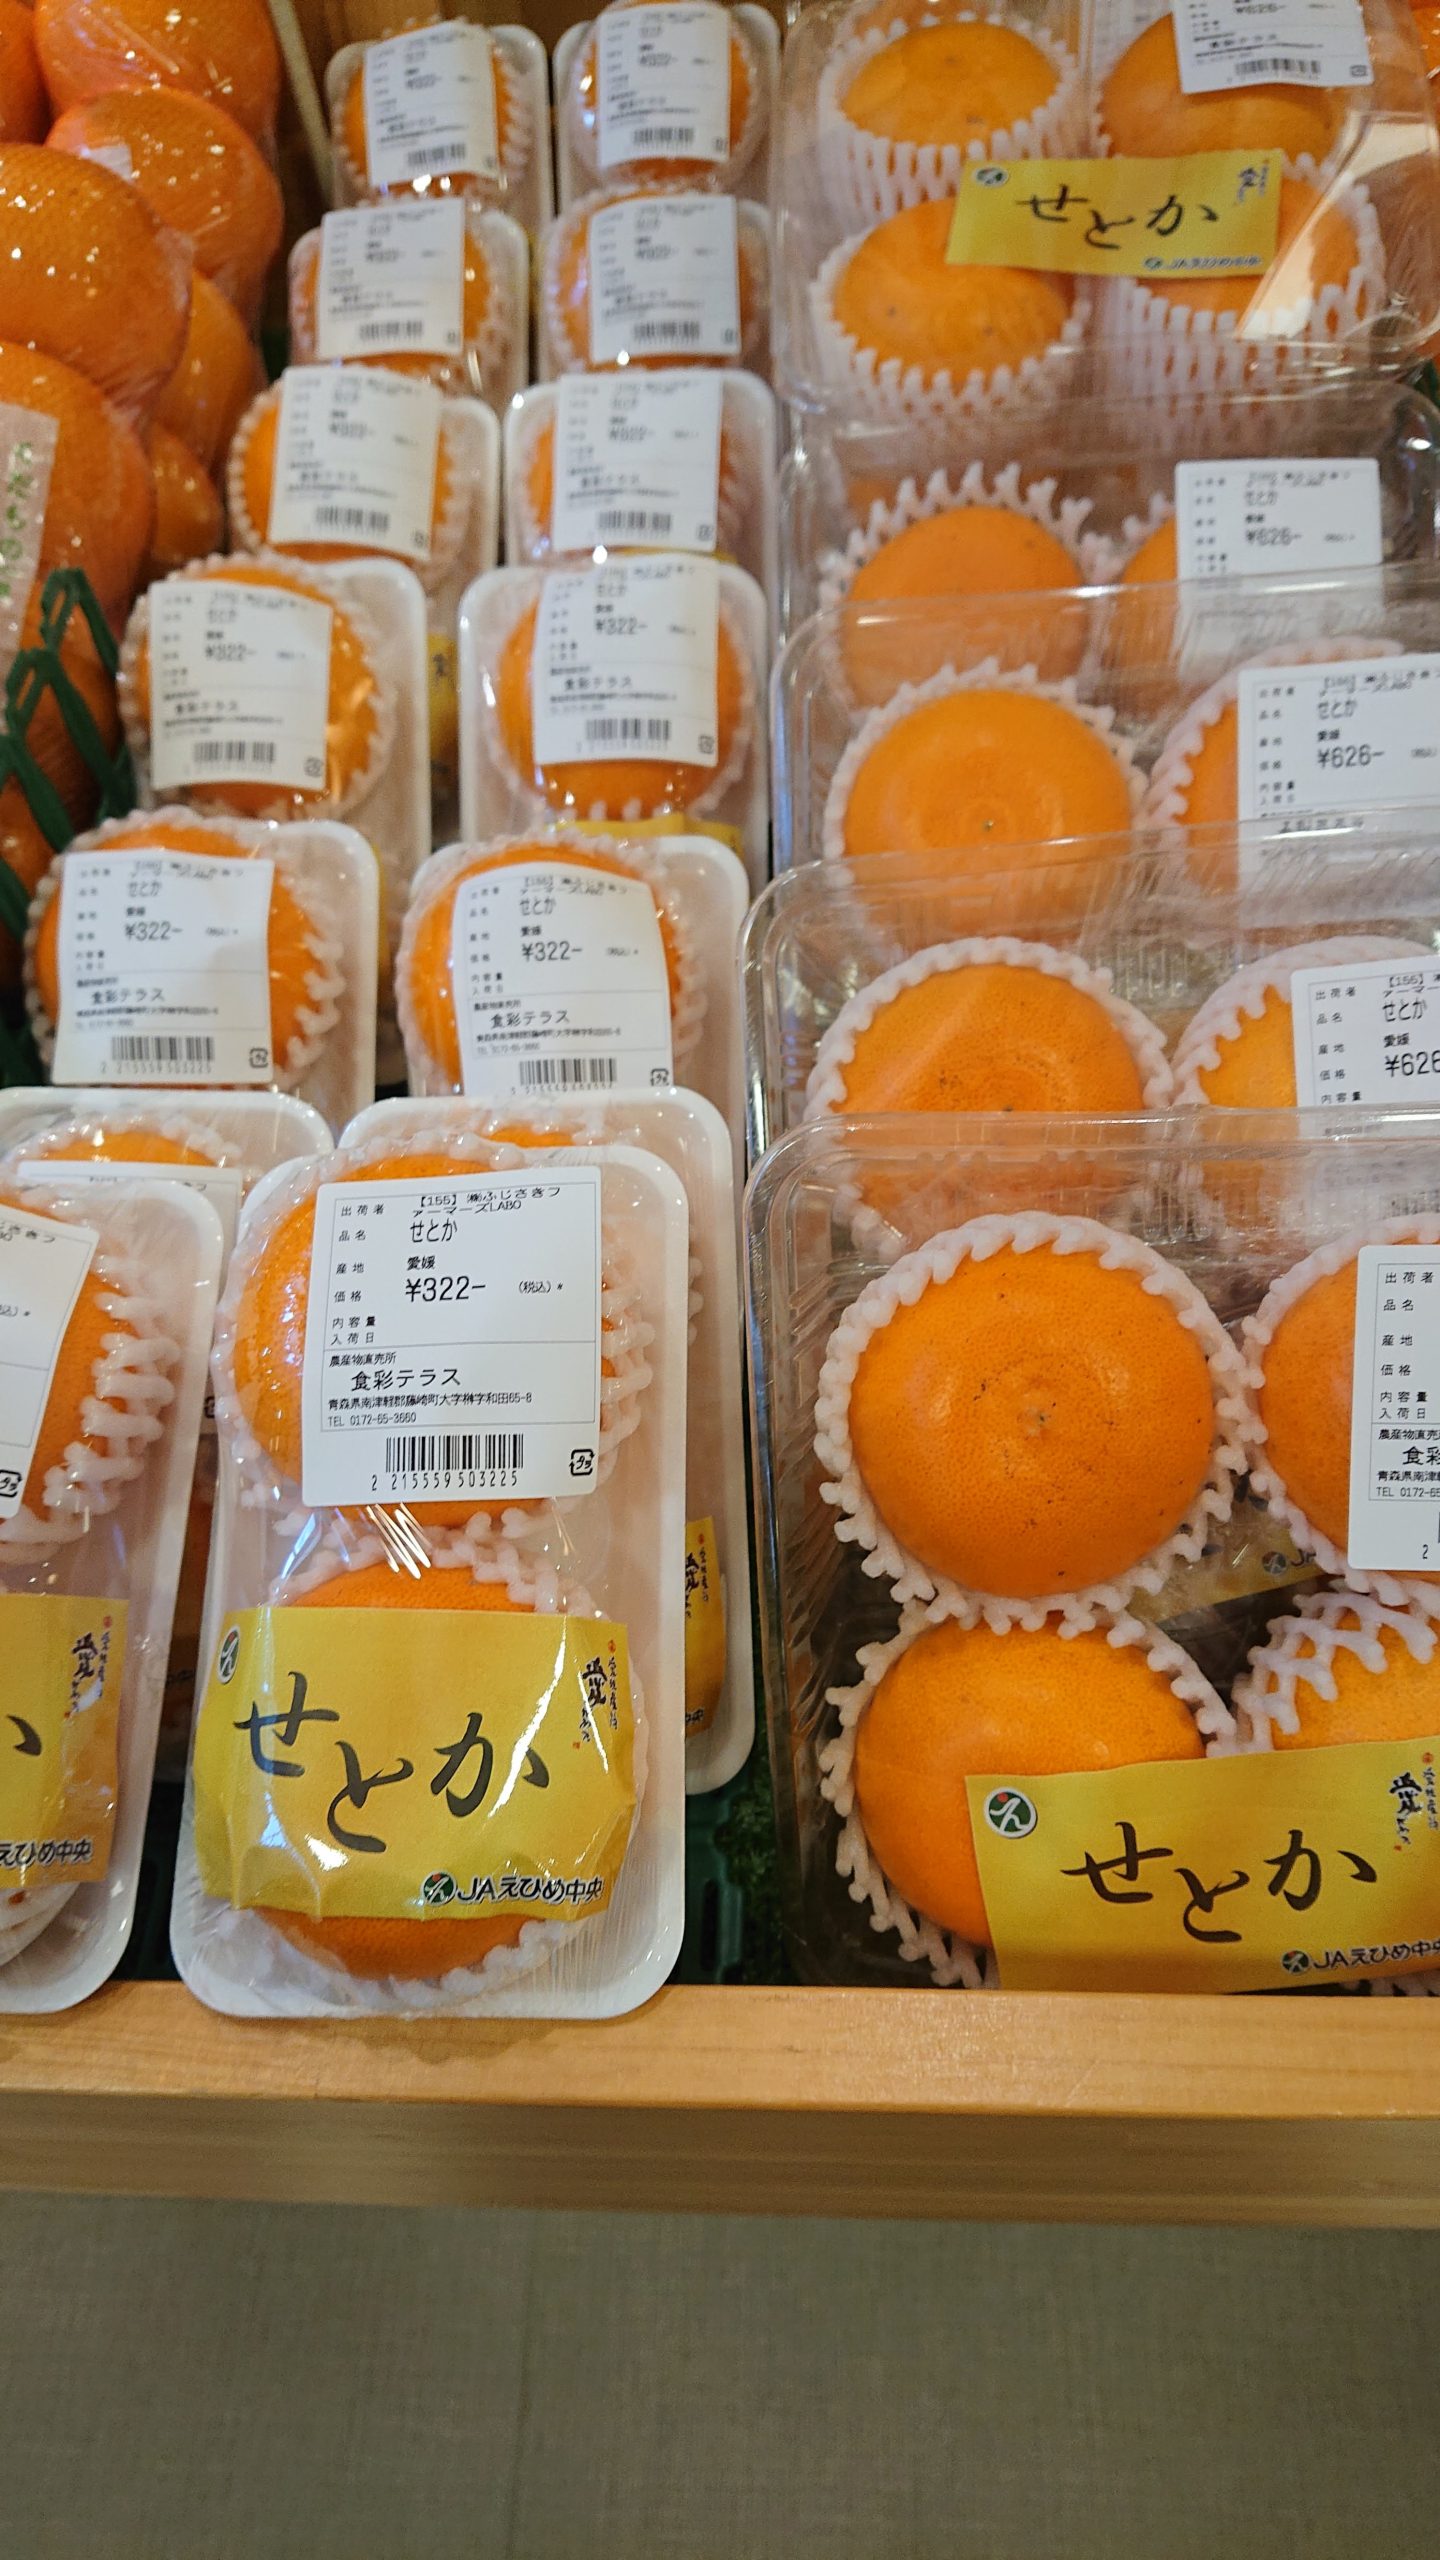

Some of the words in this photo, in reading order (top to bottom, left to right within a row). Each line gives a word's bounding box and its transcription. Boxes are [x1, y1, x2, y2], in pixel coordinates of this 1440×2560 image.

[1015, 183, 1219, 250] せとか
[1317, 743, 1385, 770] ¥626-
[125, 920, 184, 942] ¥322-
[521, 940, 584, 963] ¥322-
[490, 1009, 570, 1030] 食彩テラス
[1382, 997, 1428, 1023] せとか
[1384, 1050, 1440, 1078] ¥626
[341, 1203, 385, 1217] 出荷者
[338, 1229, 367, 1242] 品名
[409, 1218, 459, 1243] せとか
[335, 1262, 365, 1275] 産地
[406, 1255, 436, 1271] 愛媛
[1385, 1271, 1434, 1284] 出荷者
[333, 1290, 363, 1303] 価格
[405, 1275, 487, 1304] ¥322-
[1383, 1299, 1414, 1311] 品名
[332, 1316, 377, 1329] 内容量
[331, 1332, 375, 1346] 入荷日
[1381, 1334, 1413, 1347] 産地
[328, 1352, 397, 1368] 農産物直売所
[1380, 1364, 1412, 1376] 価格
[350, 1367, 462, 1391] 食彩テラス
[1380, 1391, 1428, 1403] 内容量
[328, 1415, 345, 1427] TEL
[350, 1412, 417, 1426] 0172-65-3660
[1379, 1407, 1427, 1420] 入荷日
[1376, 1487, 1394, 1497] TEL
[1422, 1544, 1429, 1559] 2
[234, 1671, 550, 1854] せとか
[457, 1875, 604, 1905] JAえひめ中央
[1060, 1821, 1378, 1943] せとか
